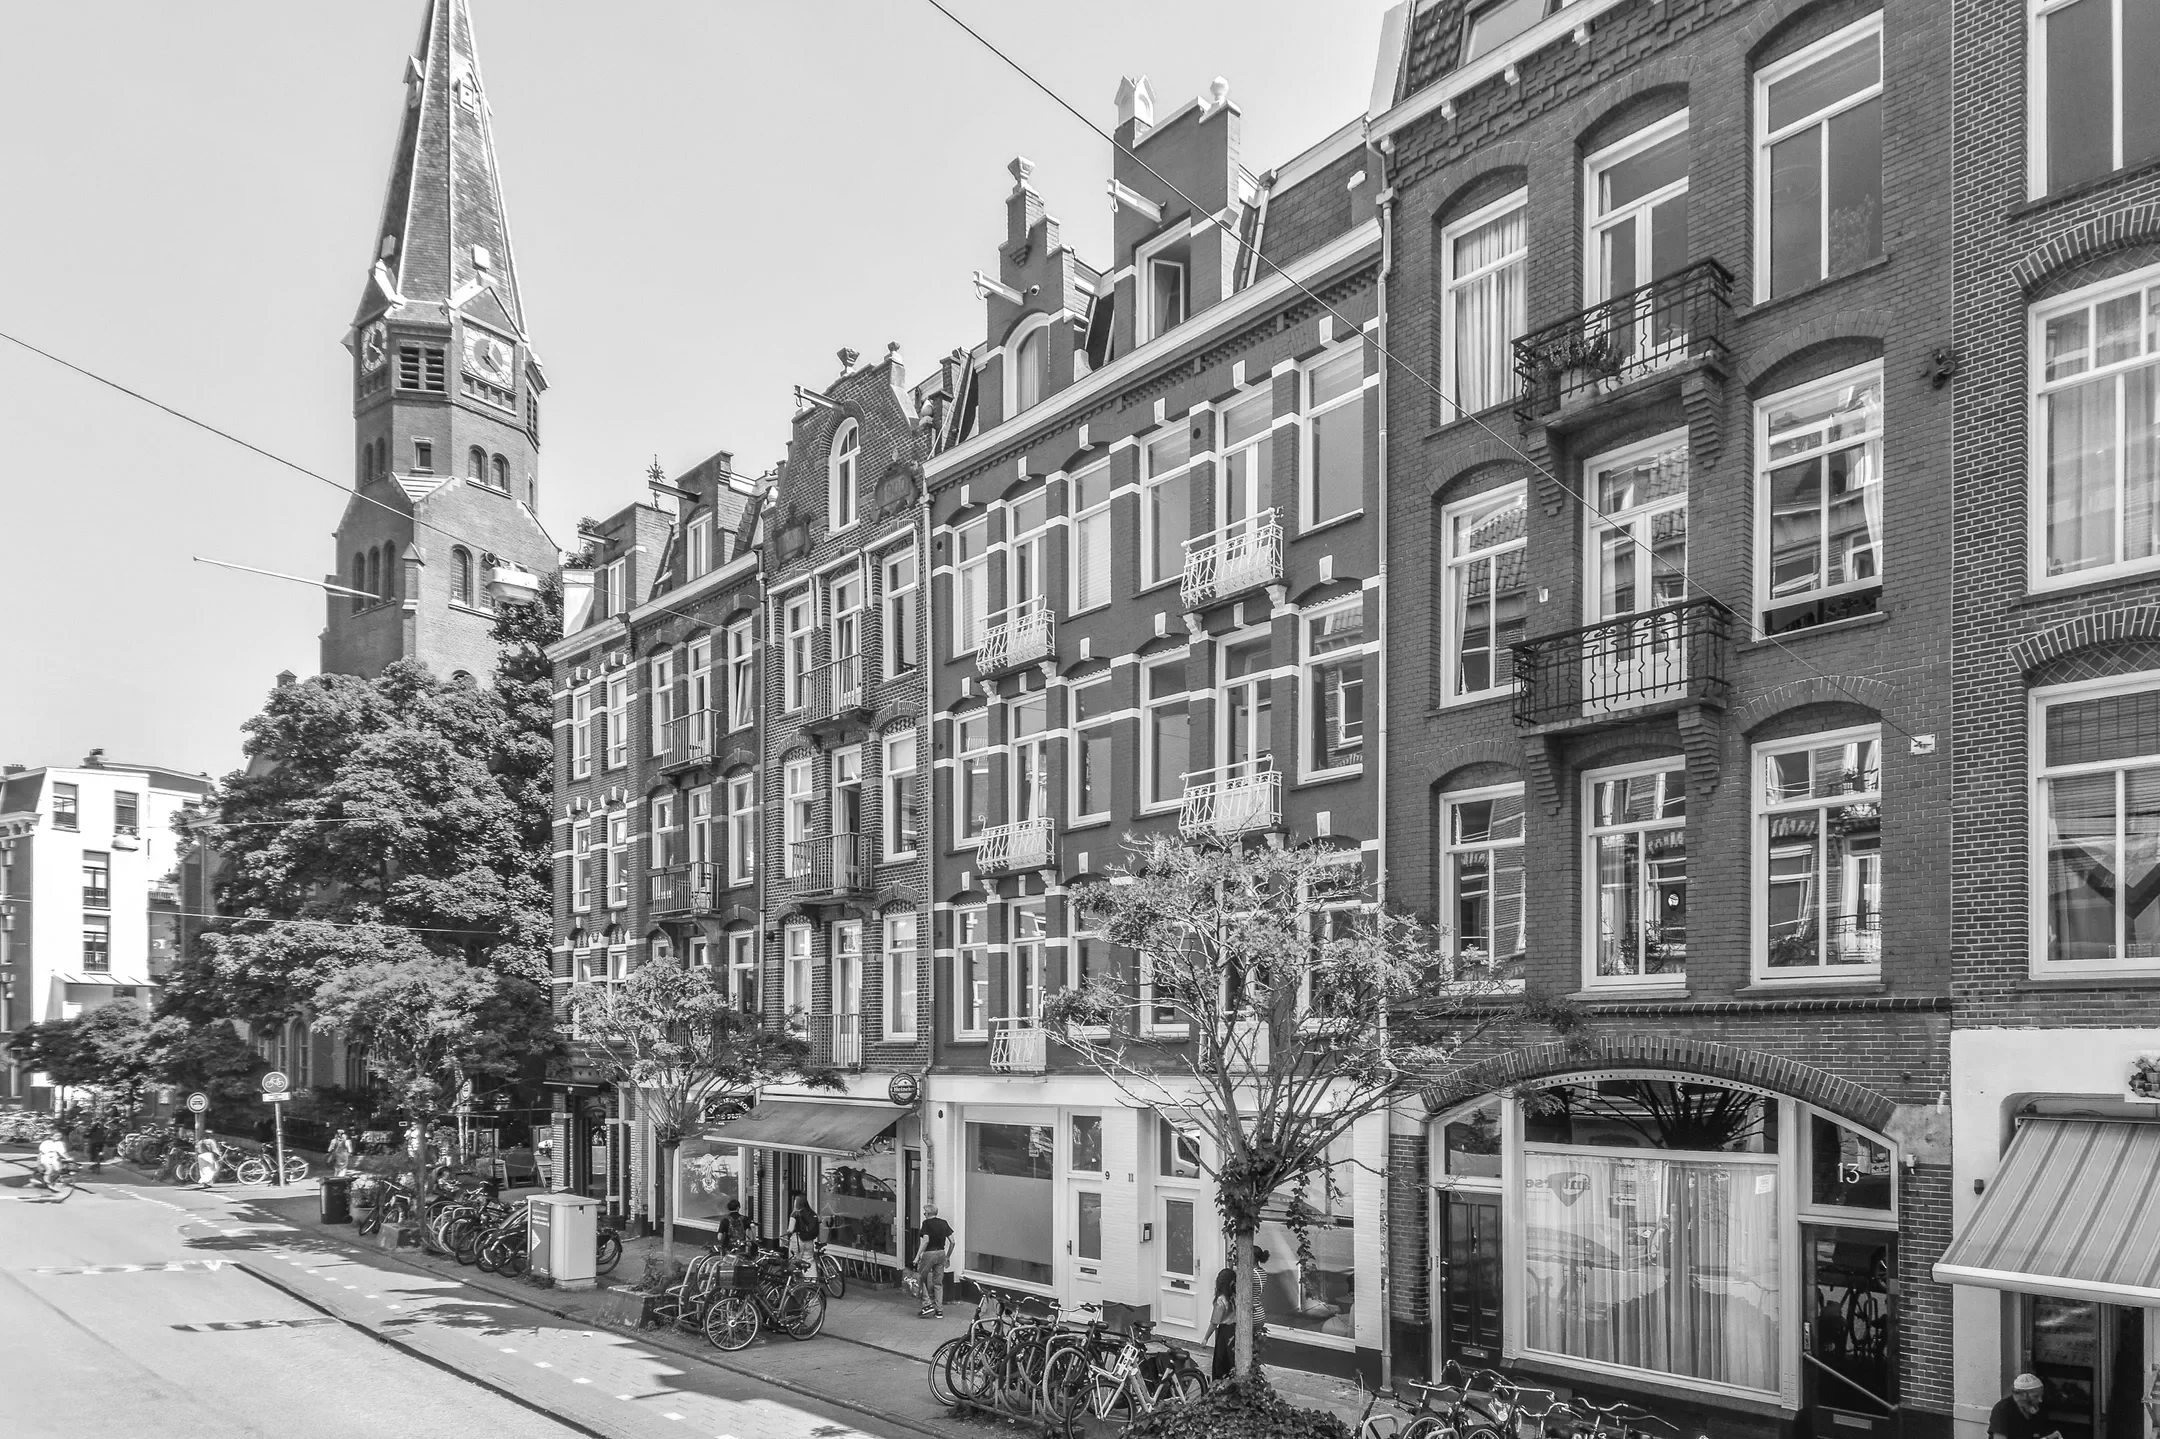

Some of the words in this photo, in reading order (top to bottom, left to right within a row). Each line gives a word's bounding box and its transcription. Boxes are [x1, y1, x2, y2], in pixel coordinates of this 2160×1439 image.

[1104, 1171, 1110, 1180] 9
[1128, 1173, 1134, 1183] 11
[1837, 1162, 1860, 1184] 13
